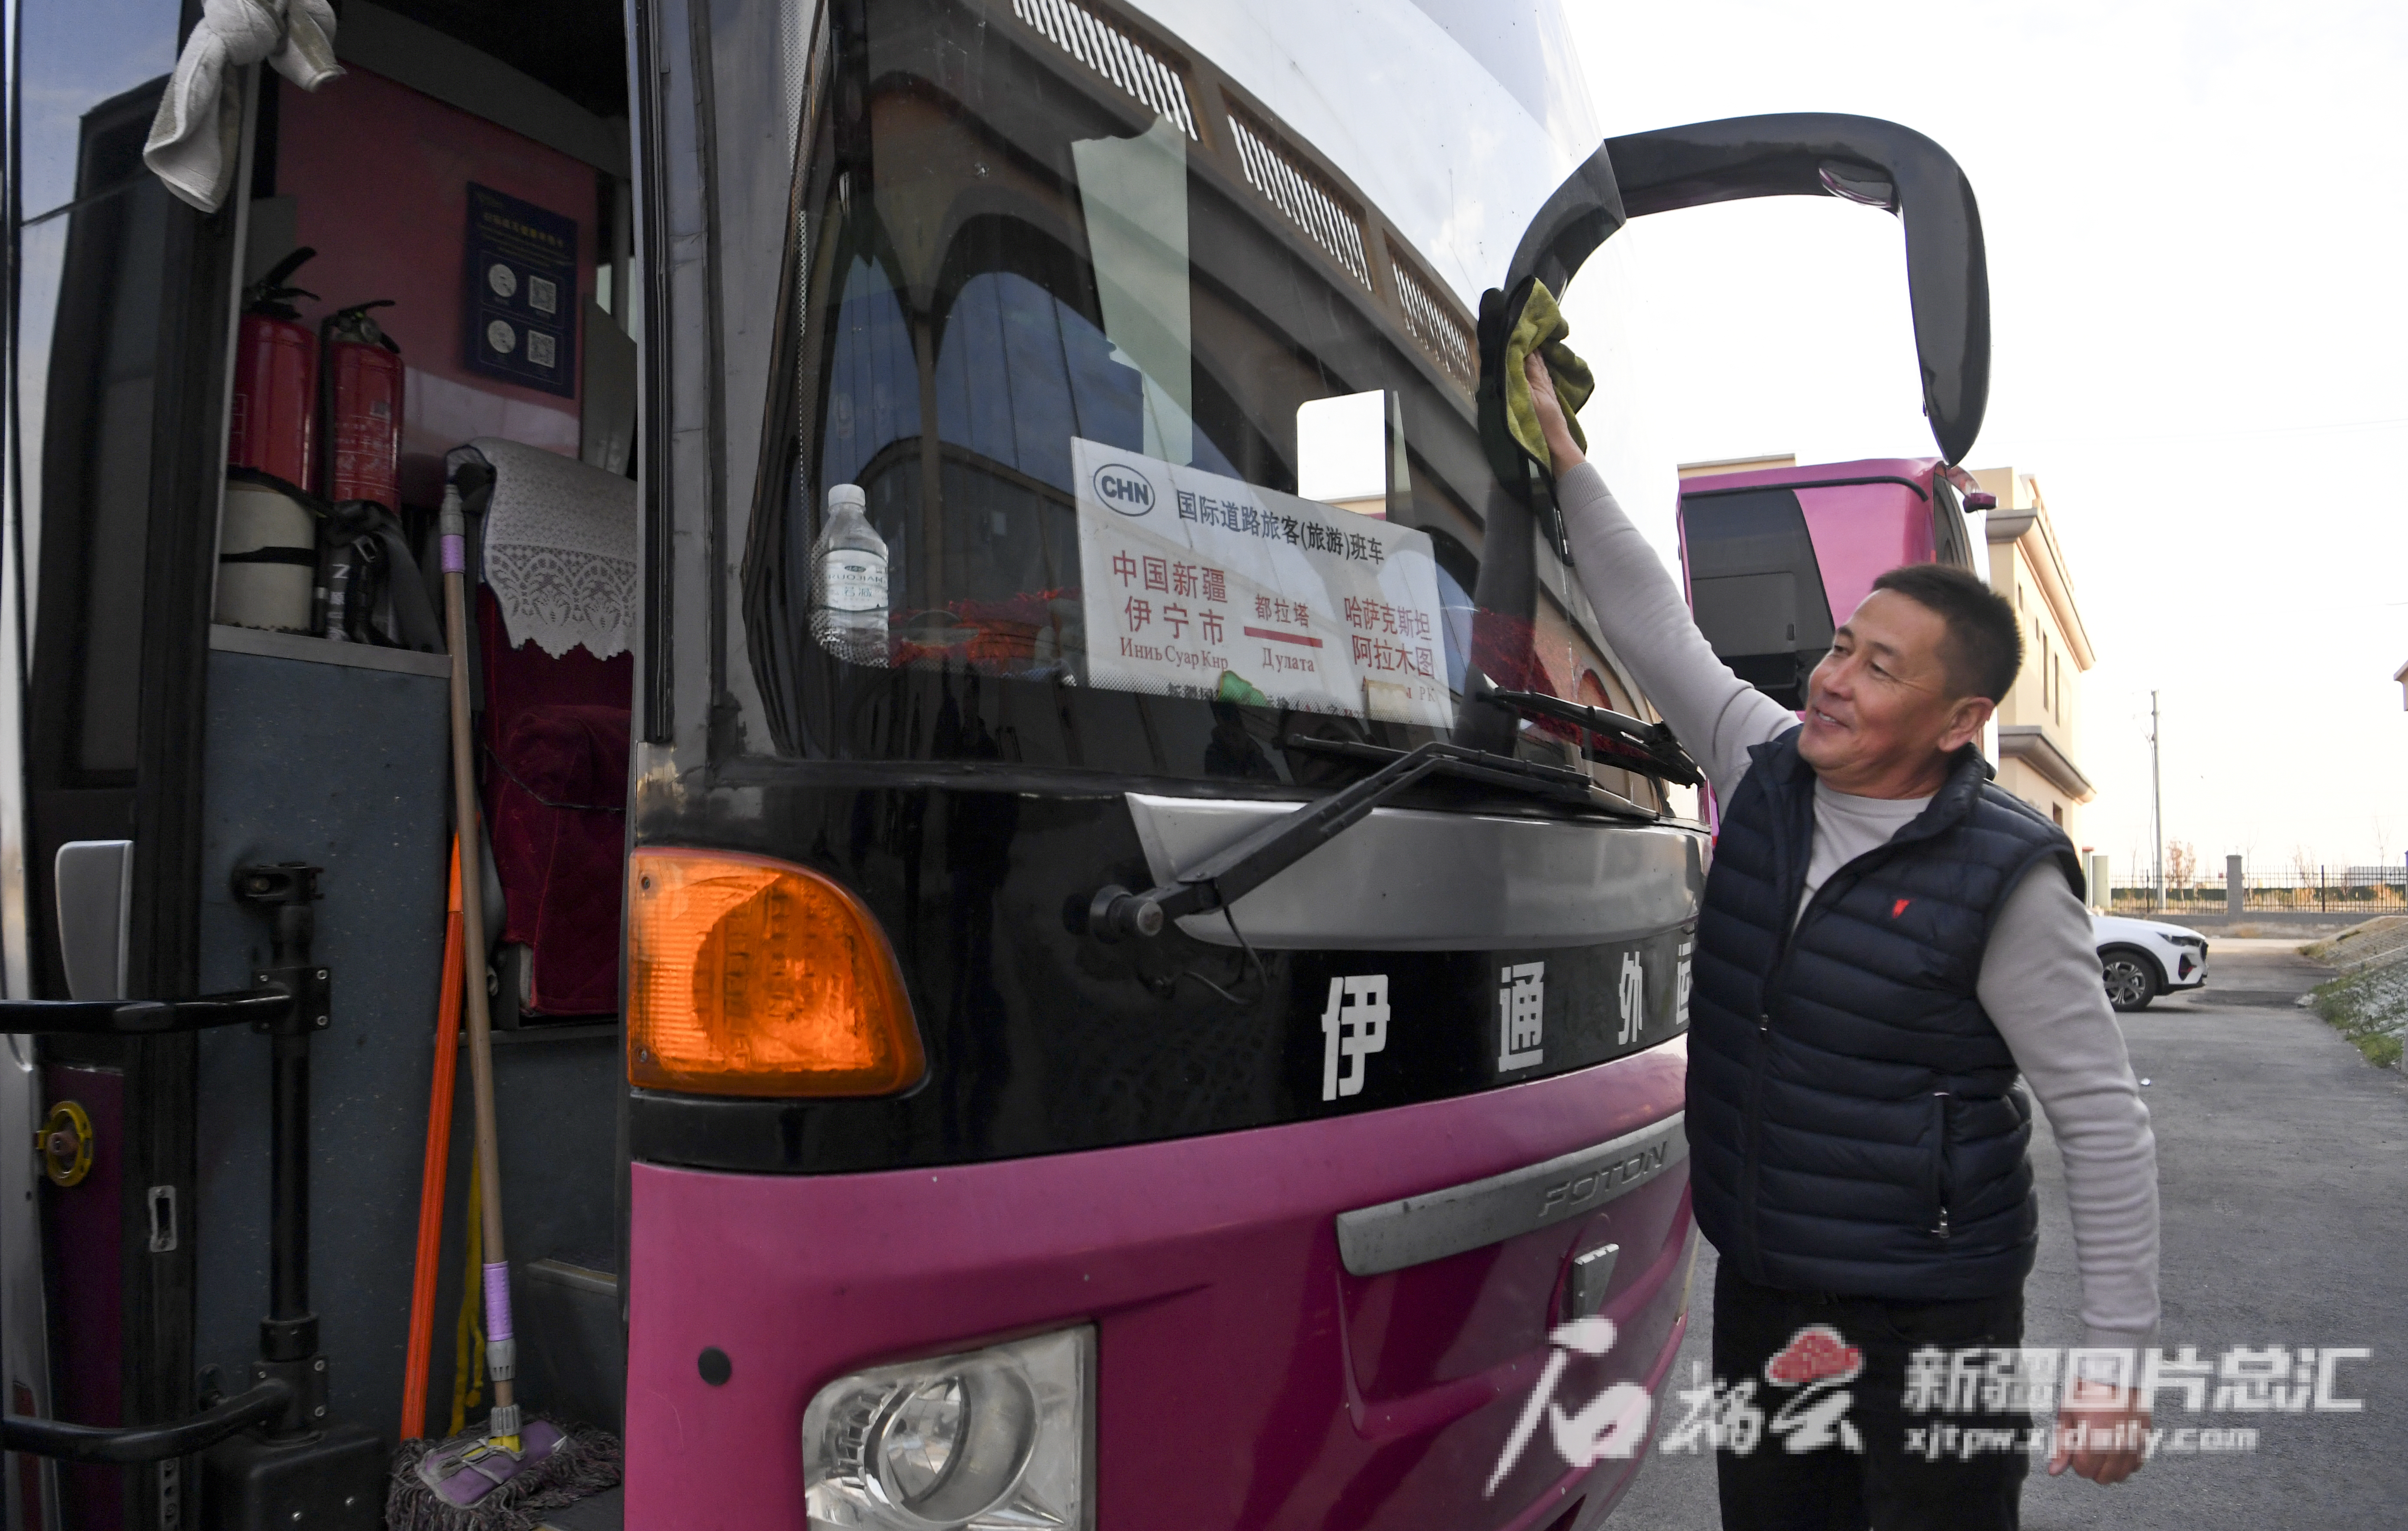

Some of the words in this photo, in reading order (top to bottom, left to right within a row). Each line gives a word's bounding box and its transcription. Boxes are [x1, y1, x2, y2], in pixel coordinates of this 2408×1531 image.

[1101, 475, 1150, 506] CHN
[1176, 489, 1384, 565] 国际道路旅客(旅游)班车
[1113, 550, 1228, 603] 中国新疆
[1125, 595, 1224, 645] 伊宁市
[1255, 593, 1310, 628] 都拉塔
[1344, 596, 1432, 641] 哈萨克斯坦
[1165, 645, 1199, 670] Суар
[1262, 648, 1315, 673] Дулата
[1352, 634, 1435, 679] 阿拉木图
[1538, 1141, 1667, 1217] FOTON
